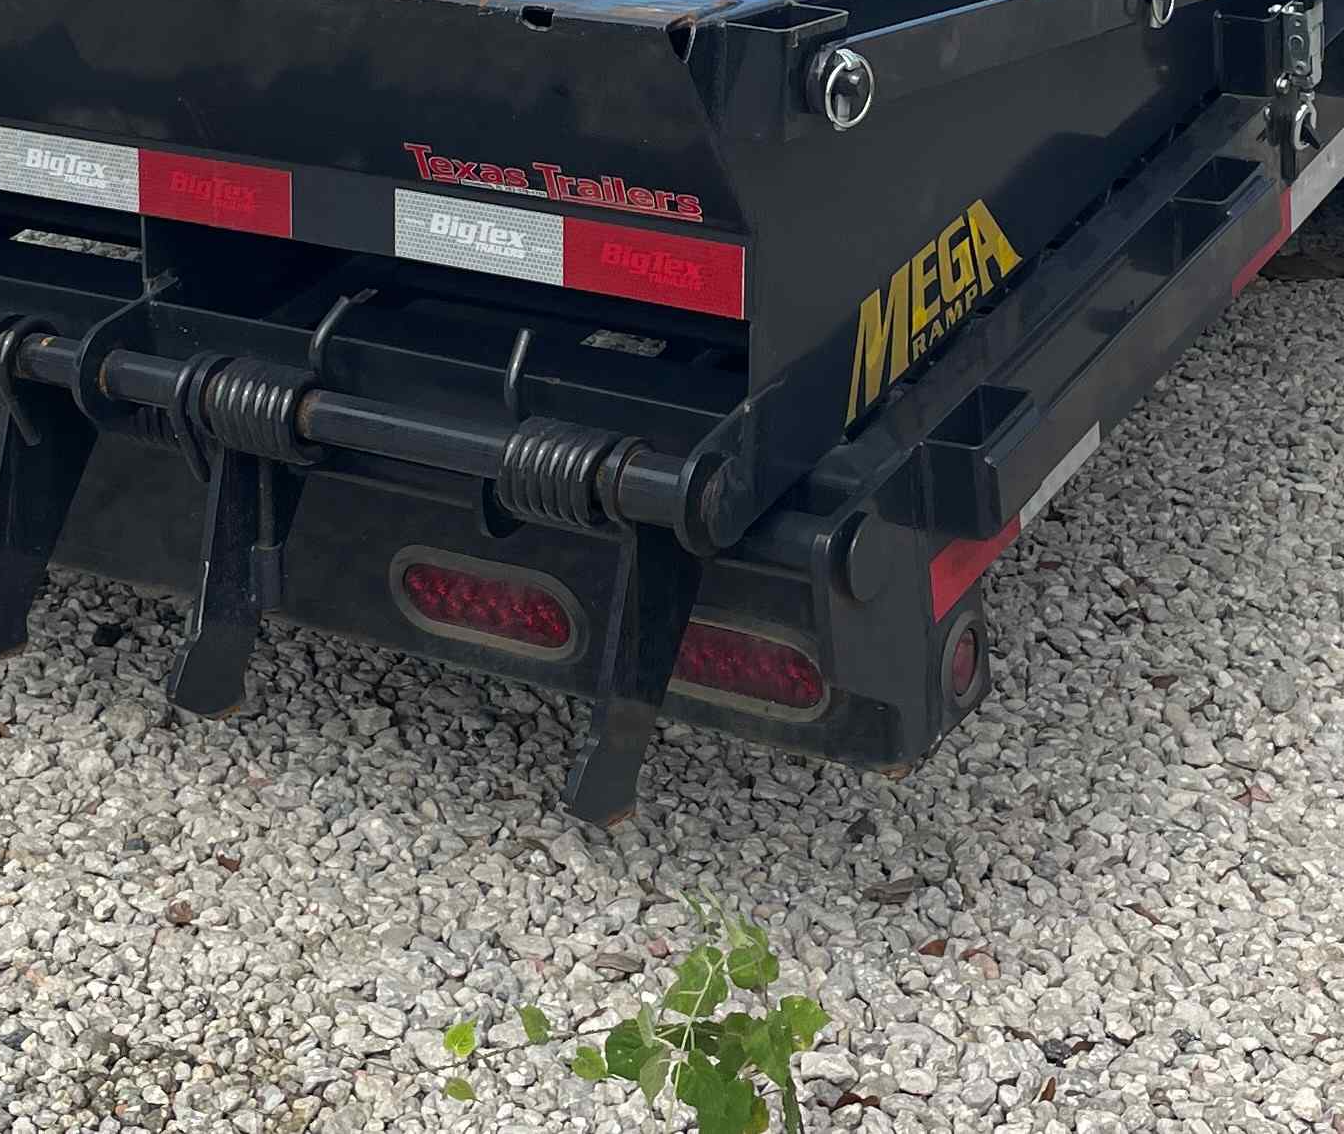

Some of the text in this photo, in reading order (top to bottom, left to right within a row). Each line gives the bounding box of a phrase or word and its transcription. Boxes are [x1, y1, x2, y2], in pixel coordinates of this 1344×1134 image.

[25, 147, 107, 180] BigTex
[403, 142, 704, 222] Texas Trailers
[429, 212, 527, 251] BigTex
[600, 241, 704, 279] BigTex
[844, 199, 1023, 428] MEGA
[912, 283, 979, 362] RAMP
